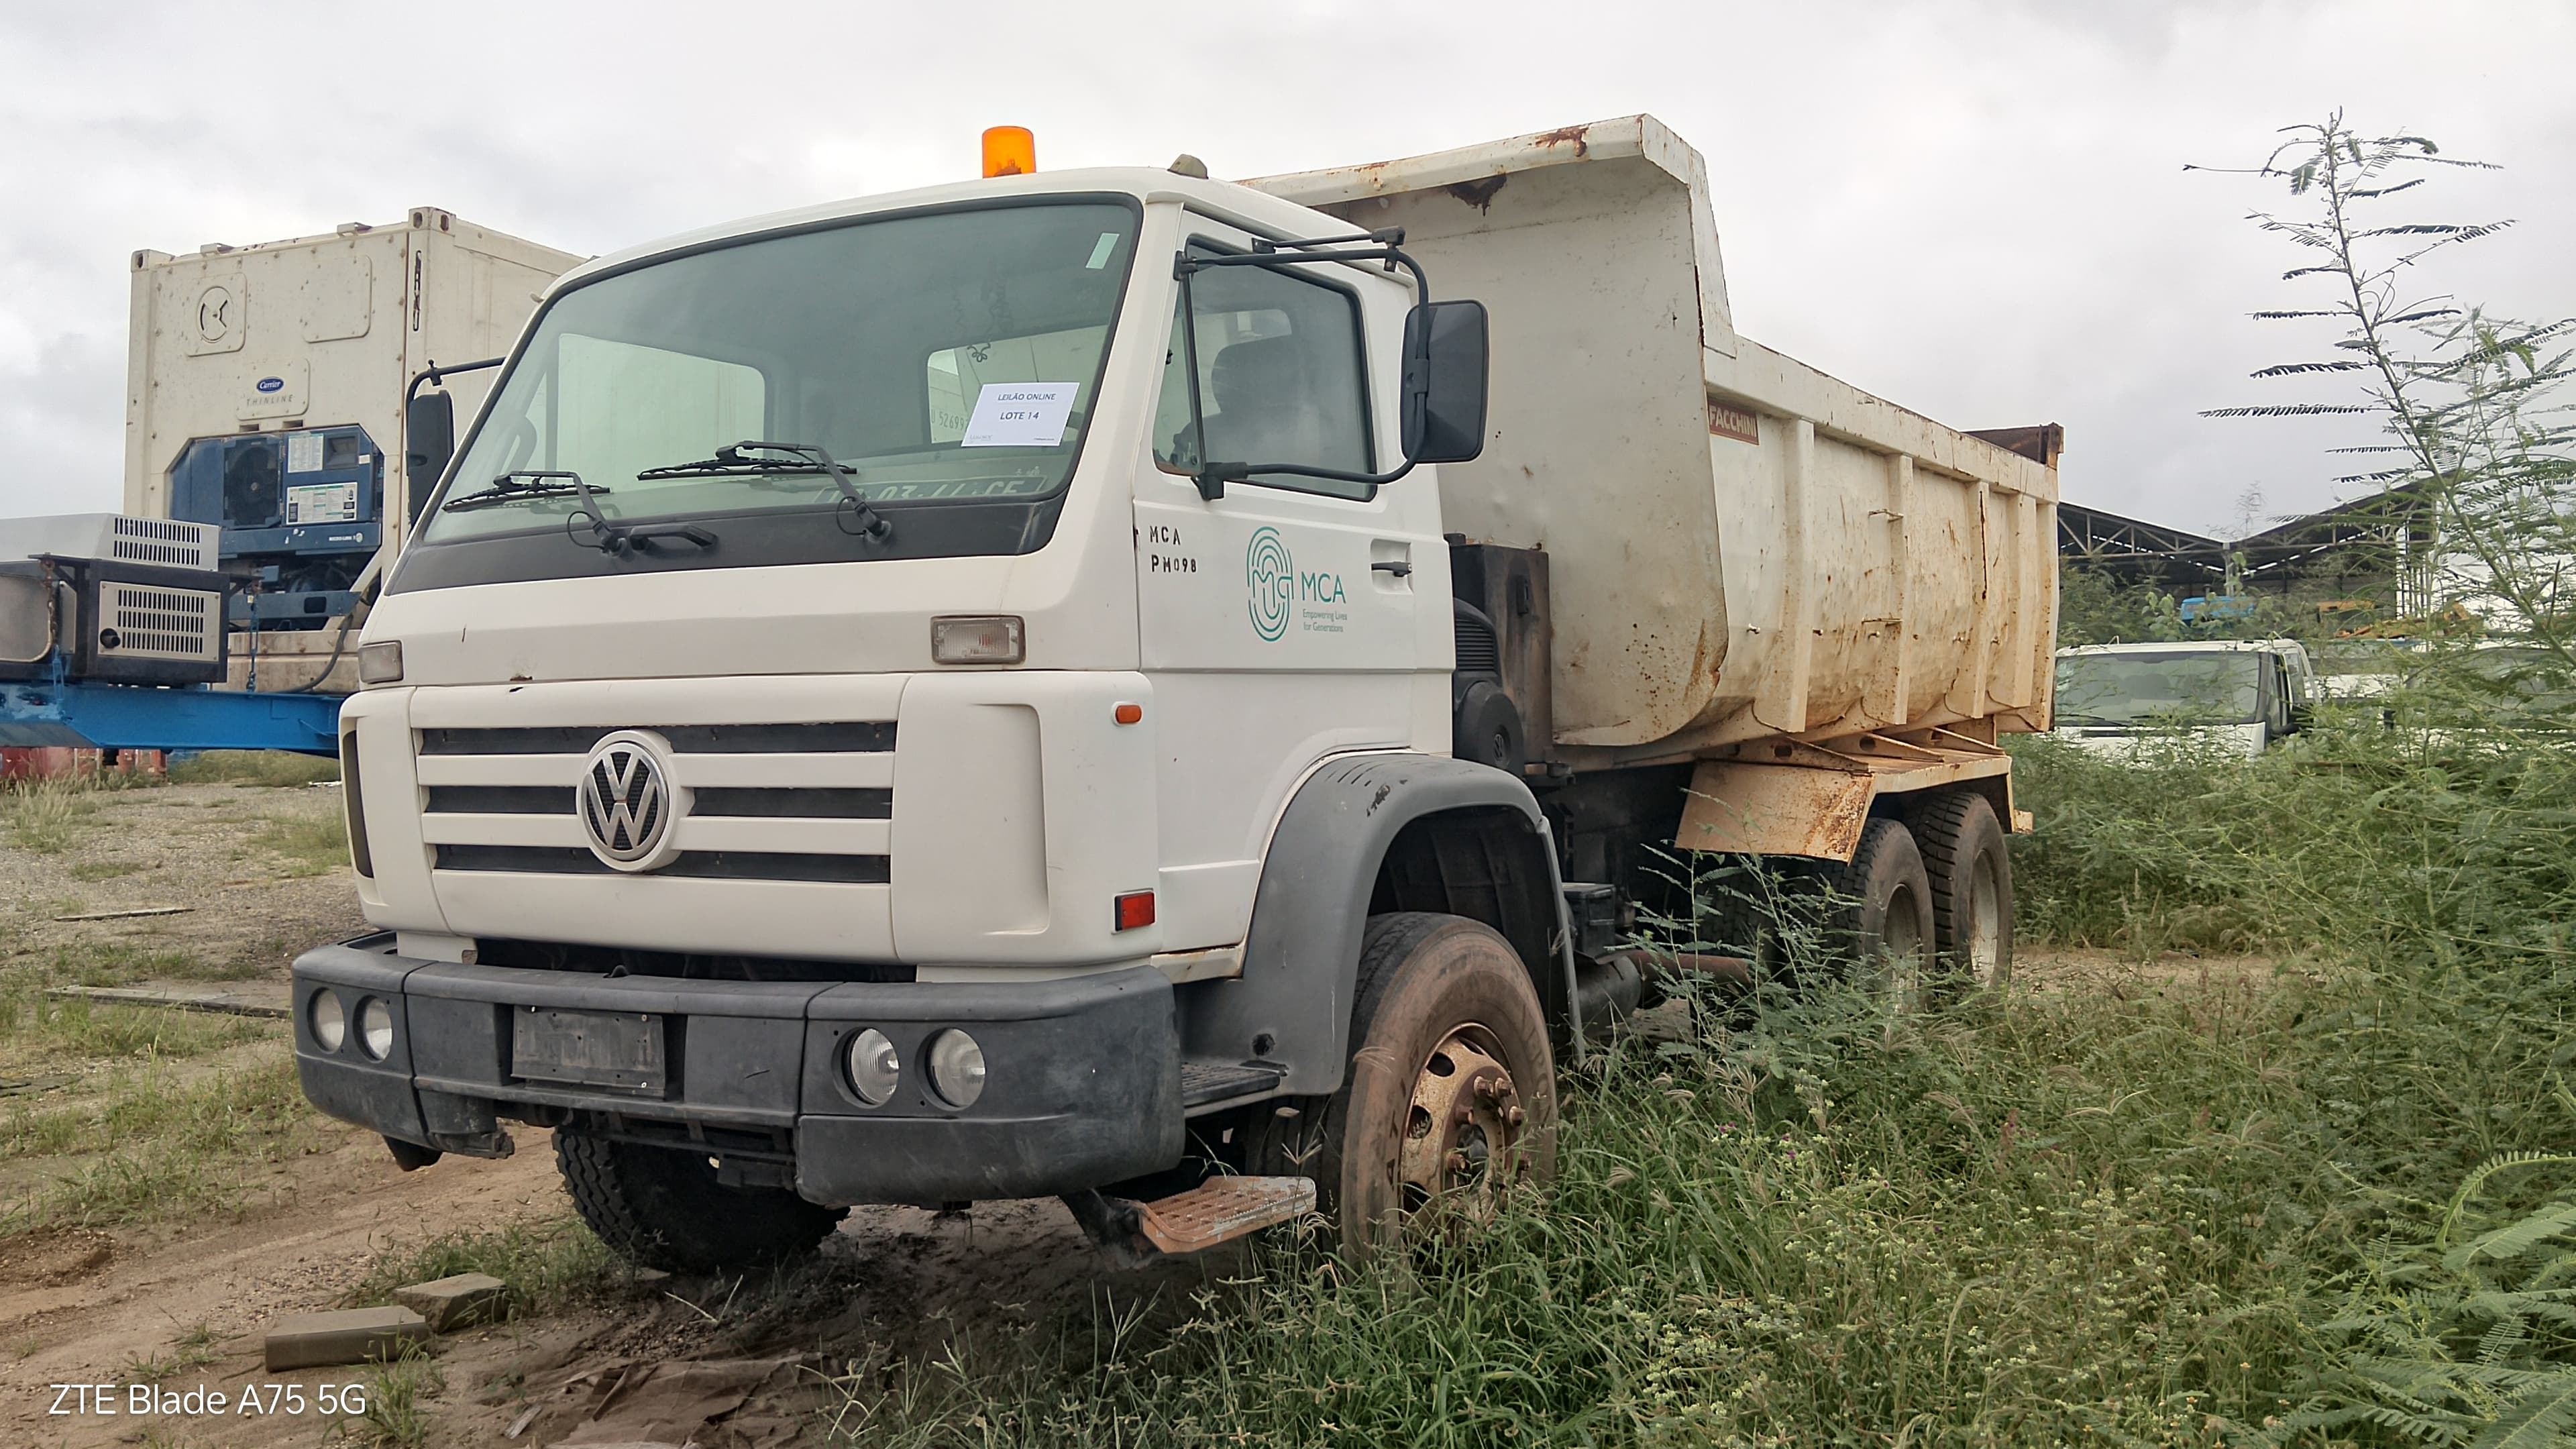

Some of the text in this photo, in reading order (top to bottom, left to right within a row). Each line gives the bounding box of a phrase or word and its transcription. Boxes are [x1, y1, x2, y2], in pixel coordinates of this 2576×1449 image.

[246, 394, 293, 407] THINLINE
[998, 392, 1024, 400] LEILÃO
[1000, 412, 1040, 420] LOTE 14
[1709, 405, 1757, 437] FACCHINI
[1150, 526, 1181, 545] MCA
[1301, 571, 1346, 604] MCA
[582, 743, 667, 857] VW
